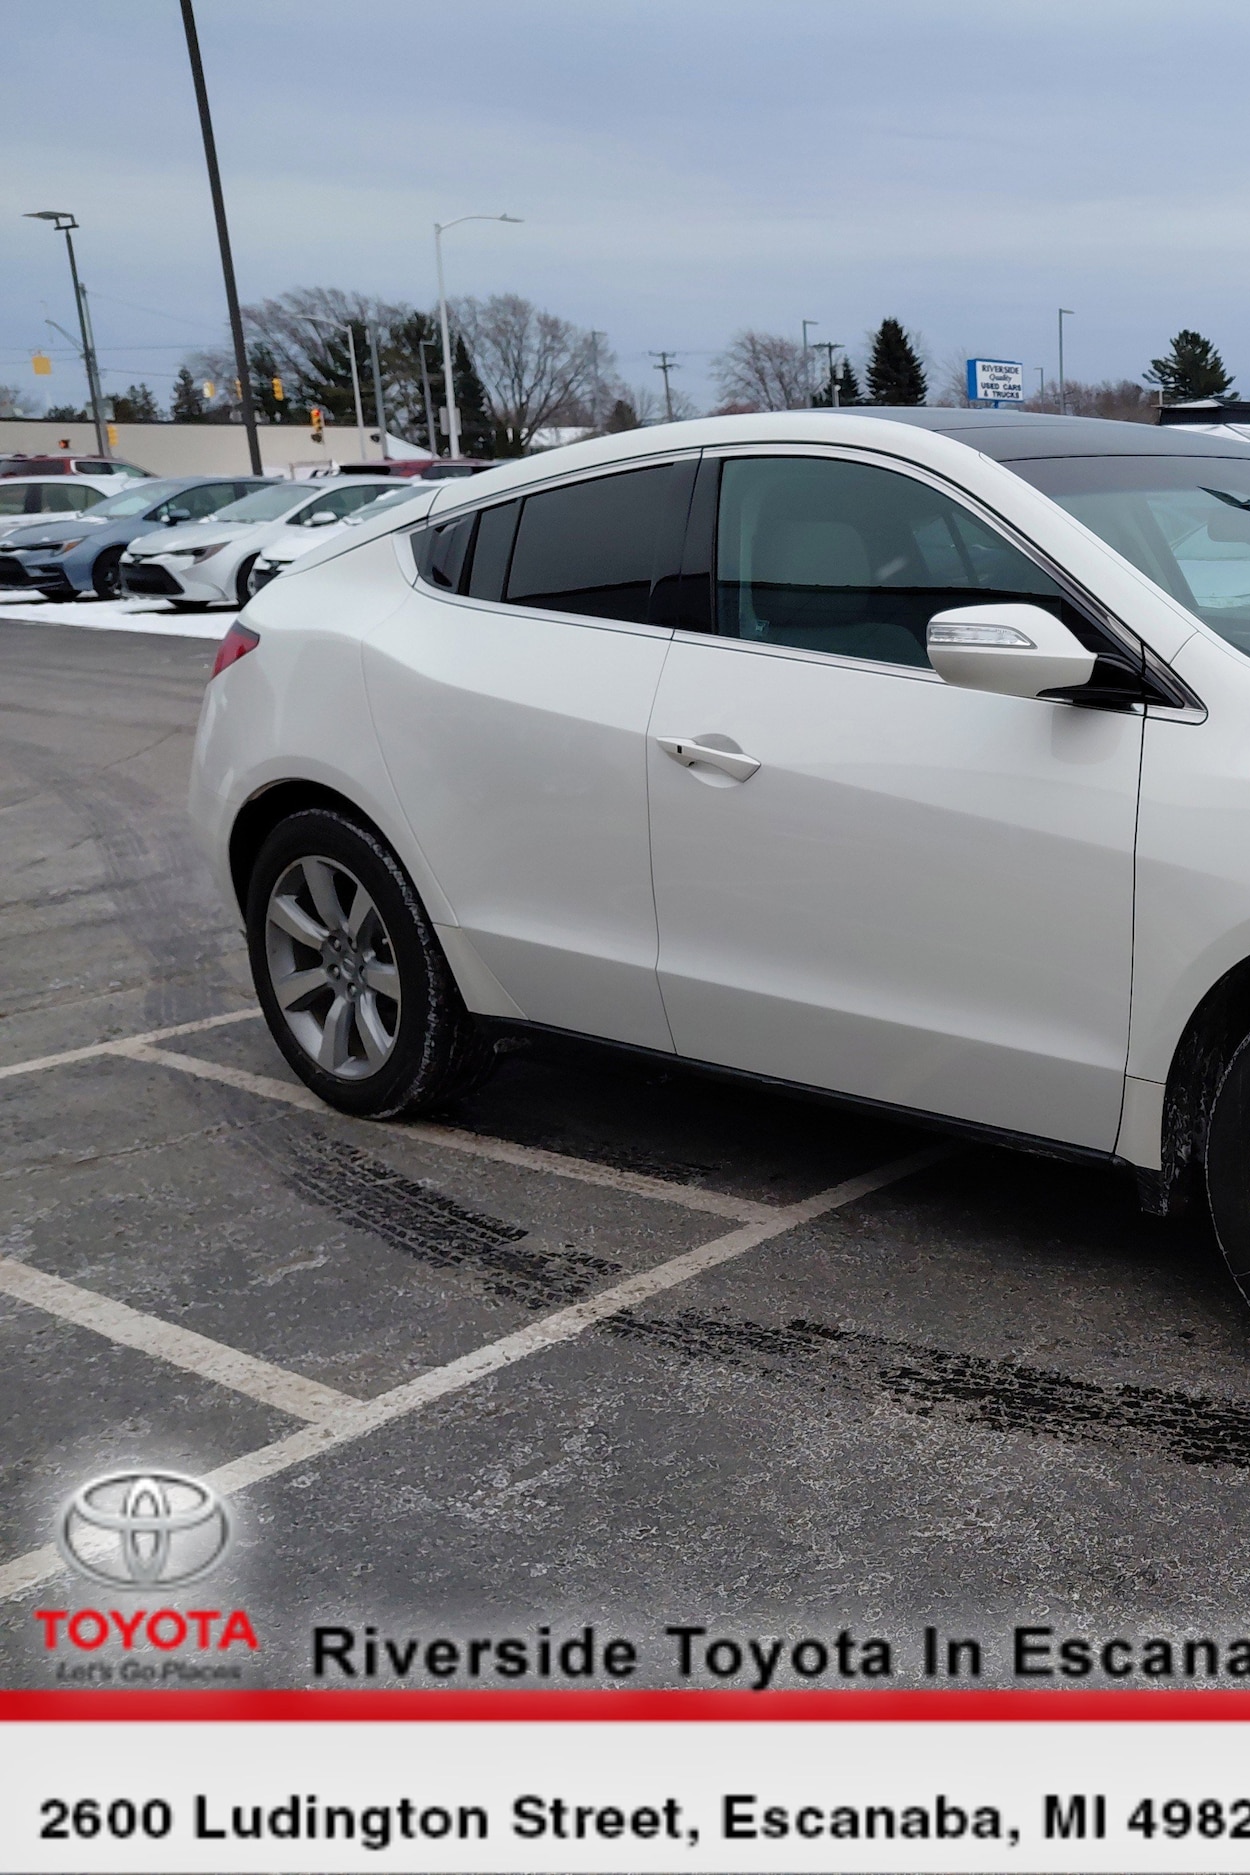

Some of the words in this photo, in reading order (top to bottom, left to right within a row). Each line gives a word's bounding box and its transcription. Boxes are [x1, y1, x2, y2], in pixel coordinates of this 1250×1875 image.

[981, 364, 1020, 374] RIVERSIDE
[989, 373, 1012, 383] Quality
[980, 382, 1000, 390] USED
[1002, 383, 1021, 391] CARS
[992, 390, 1020, 399] TRUCKS
